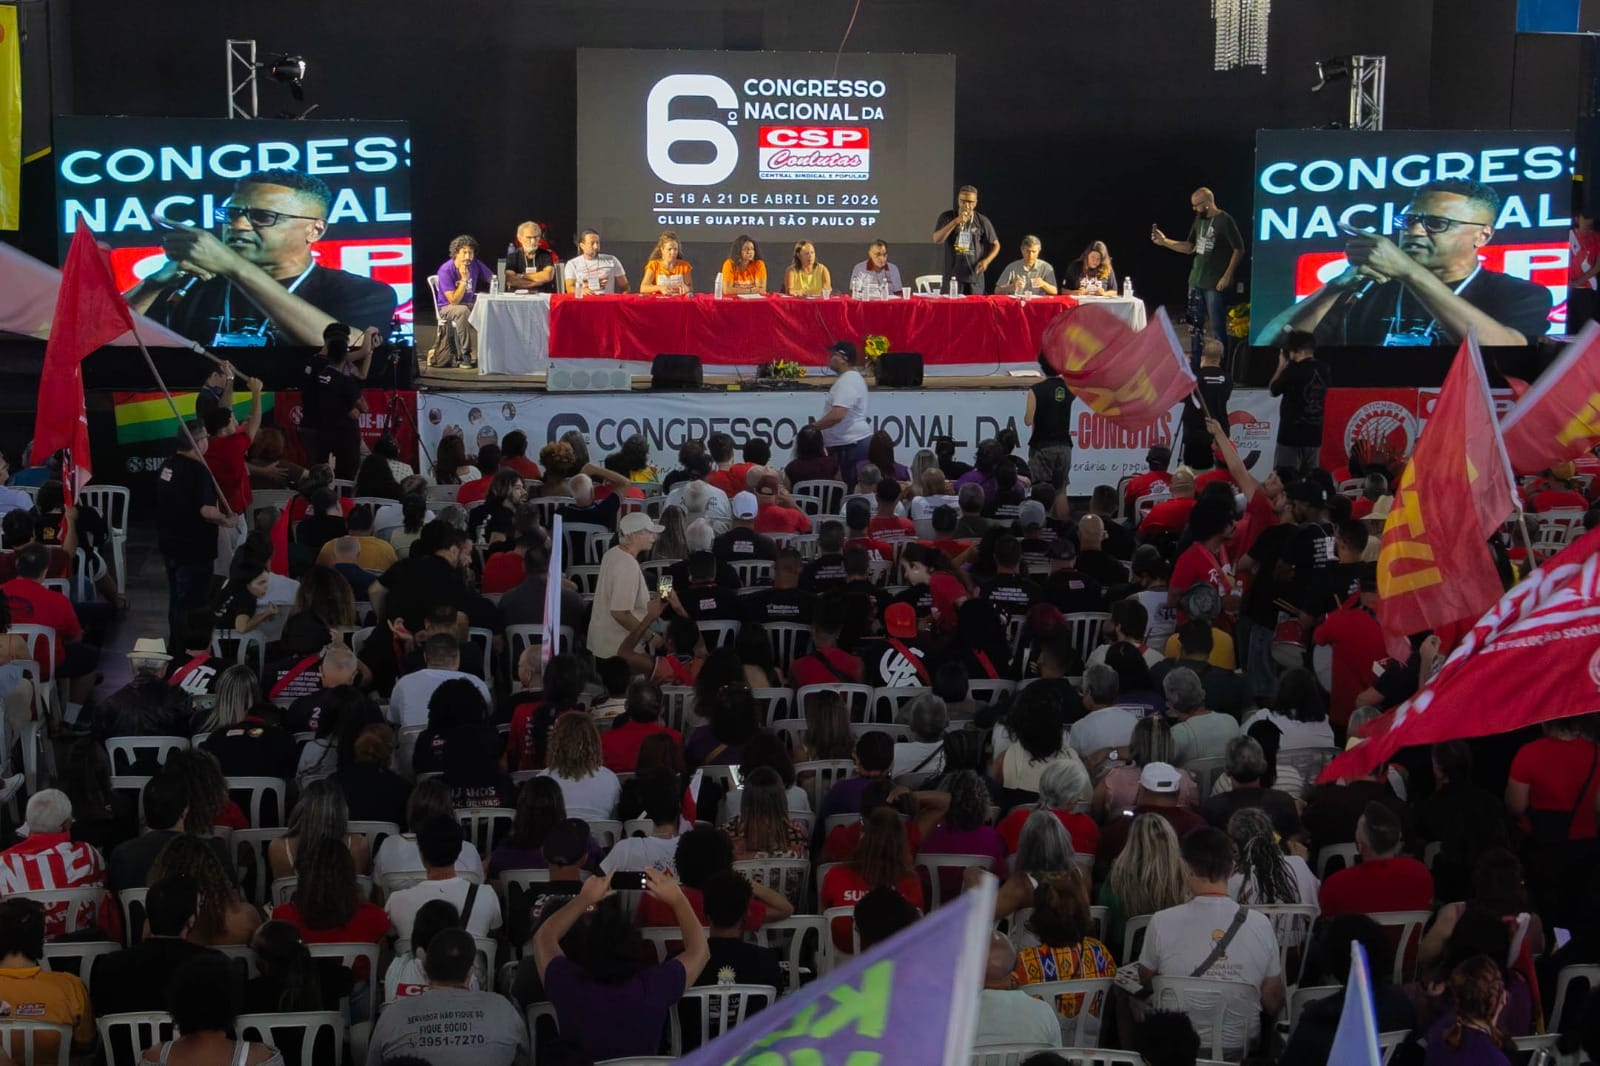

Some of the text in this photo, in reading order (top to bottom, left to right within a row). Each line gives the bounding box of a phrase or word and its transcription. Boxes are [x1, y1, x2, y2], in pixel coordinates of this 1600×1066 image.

[743, 77, 887, 99] CONGRESSO
[744, 102, 859, 121] NACIONAL
[861, 106, 885, 121] DA
[766, 129, 863, 147] CSP
[61, 136, 411, 185] CONGRES
[767, 149, 862, 170] Conlutas
[1260, 145, 1576, 195] CONGRES
[655, 192, 879, 206] DE 18 A 21 DE ABRIL DE 2026
[64, 186, 412, 235] NACIAL
[657, 214, 877, 227] CLUBE GUAPIRA SÃO PAULO SP
[1260, 193, 1572, 241] NACIAL
[418, 1034, 485, 1047] 3951-7270
